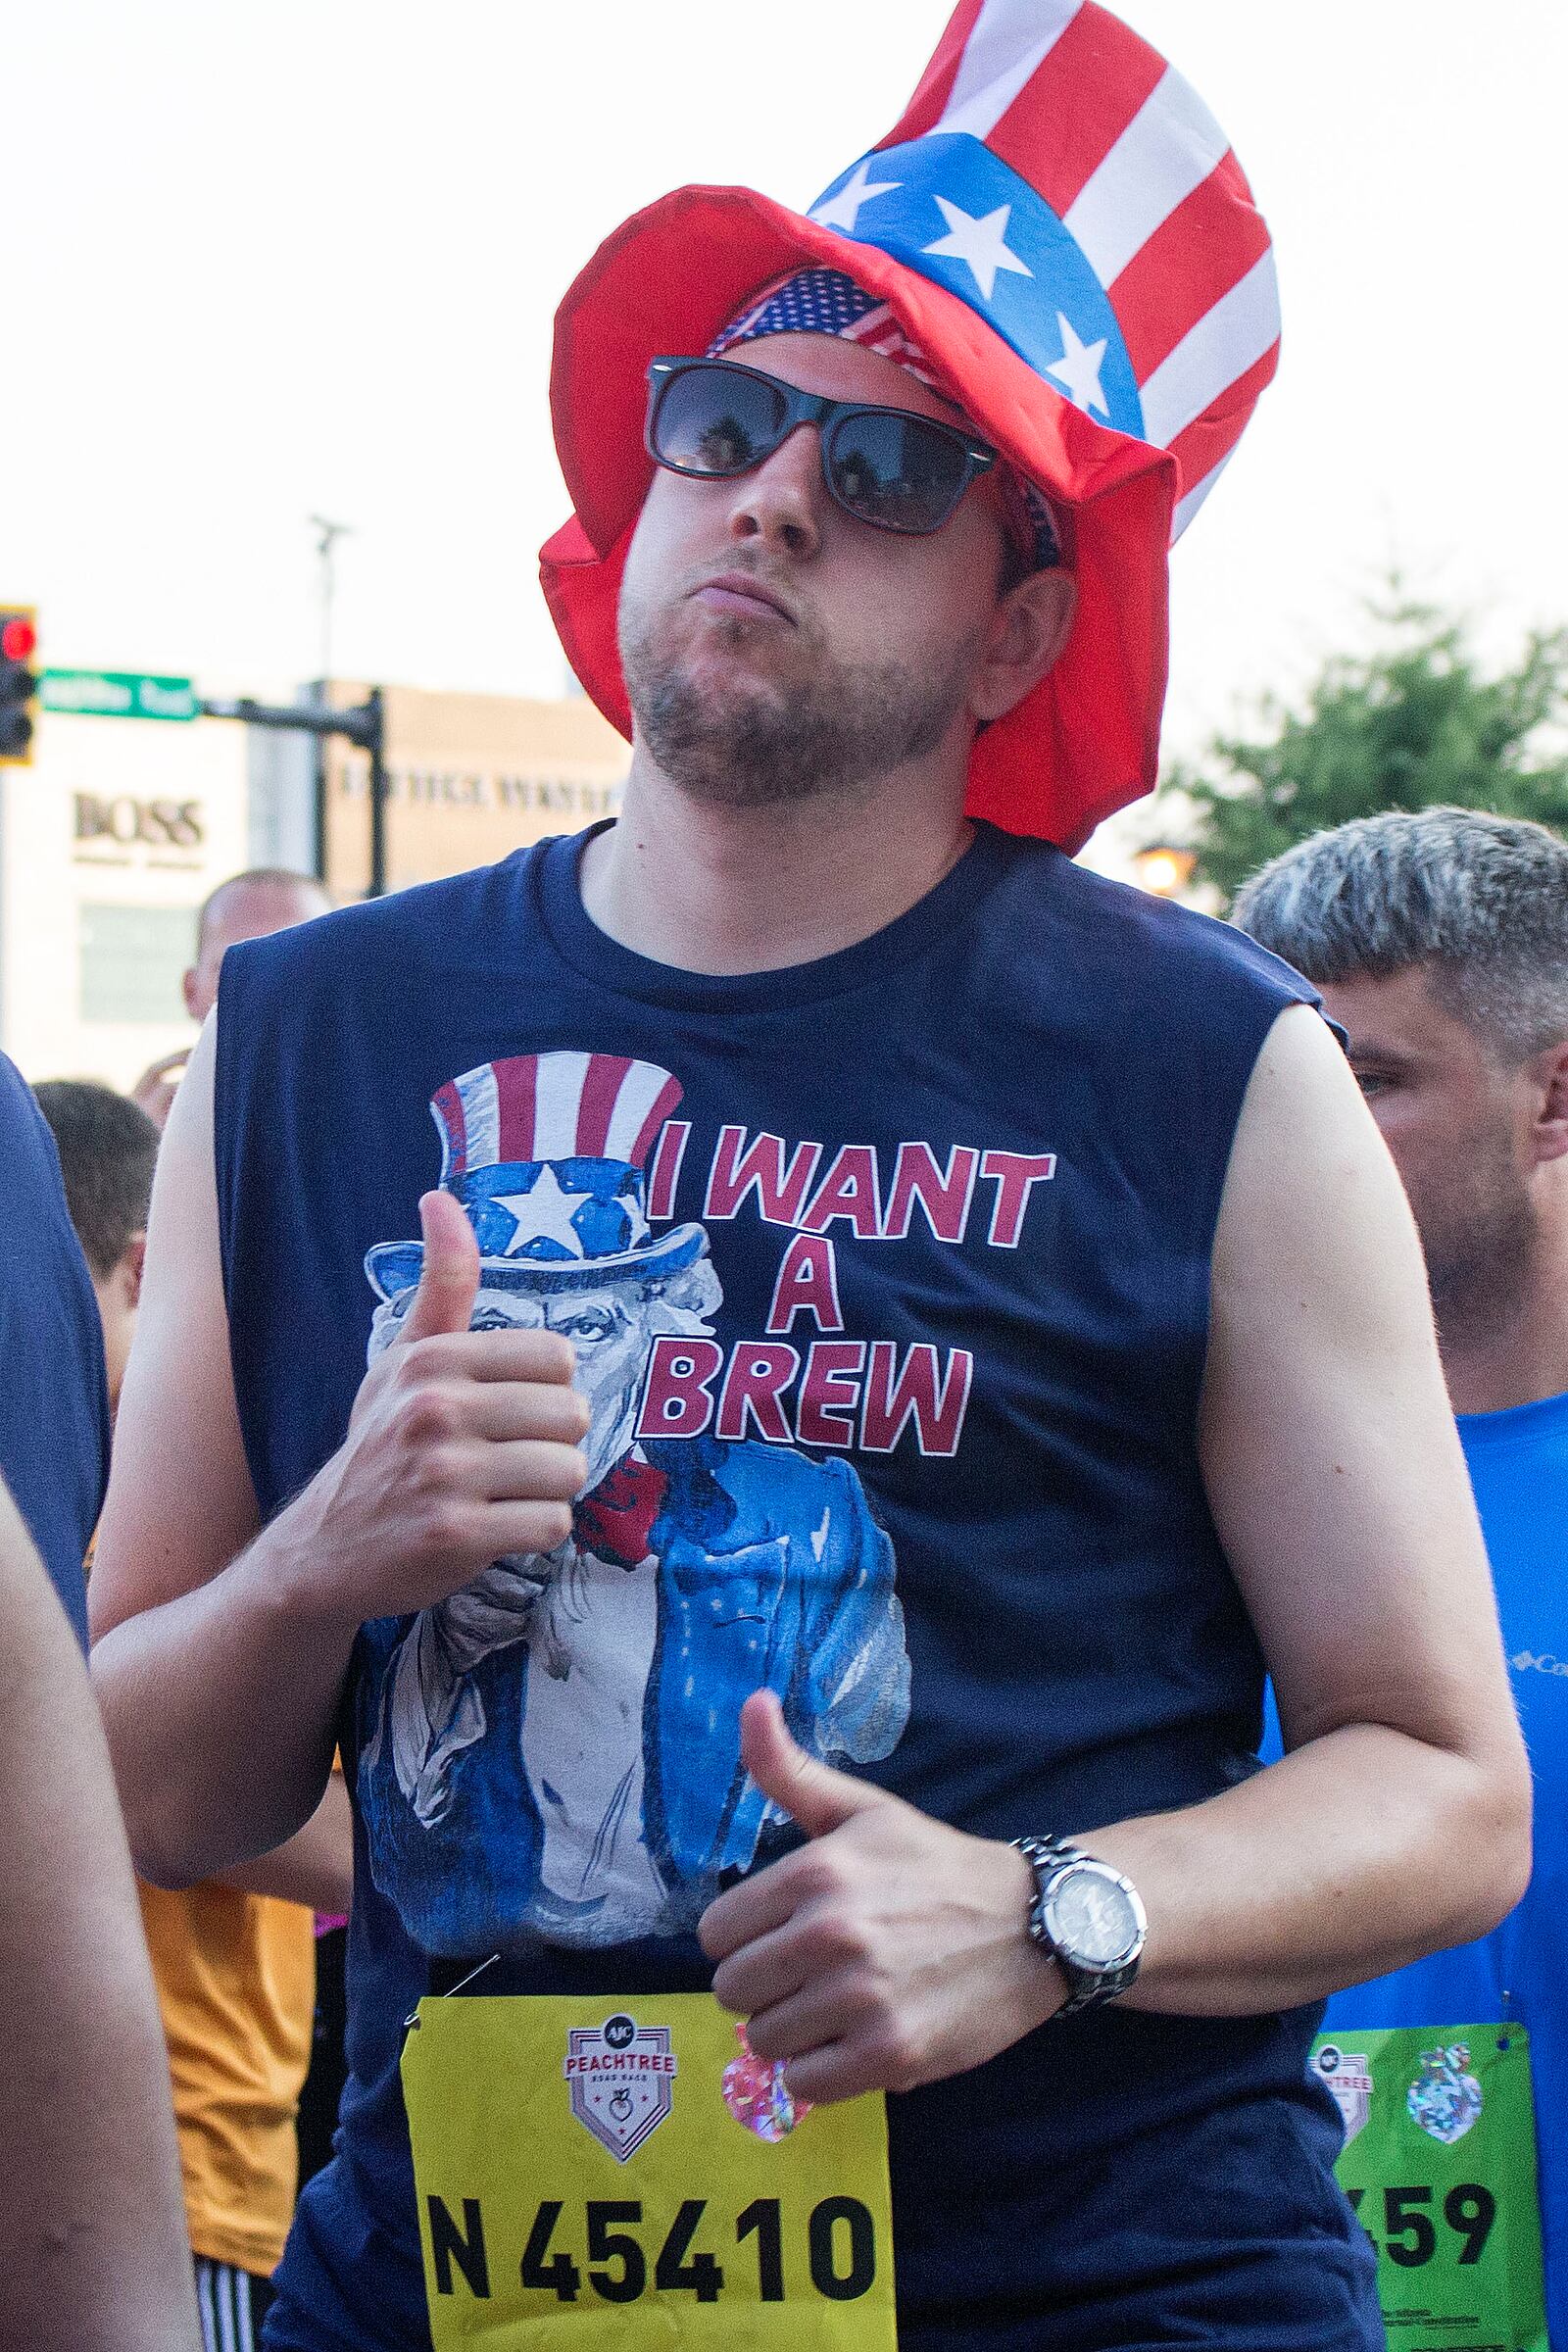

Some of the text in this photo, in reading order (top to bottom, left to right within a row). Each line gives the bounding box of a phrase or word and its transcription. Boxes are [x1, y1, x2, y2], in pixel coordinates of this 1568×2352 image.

[74, 794, 204, 847] BOSS
[646, 1120, 1056, 1249] I WANT
[765, 1233, 844, 1334] A
[634, 1336, 973, 1457] BREW
[566, 2053, 675, 2075] PEACHTREE
[427, 2194, 876, 2303] N 45410
